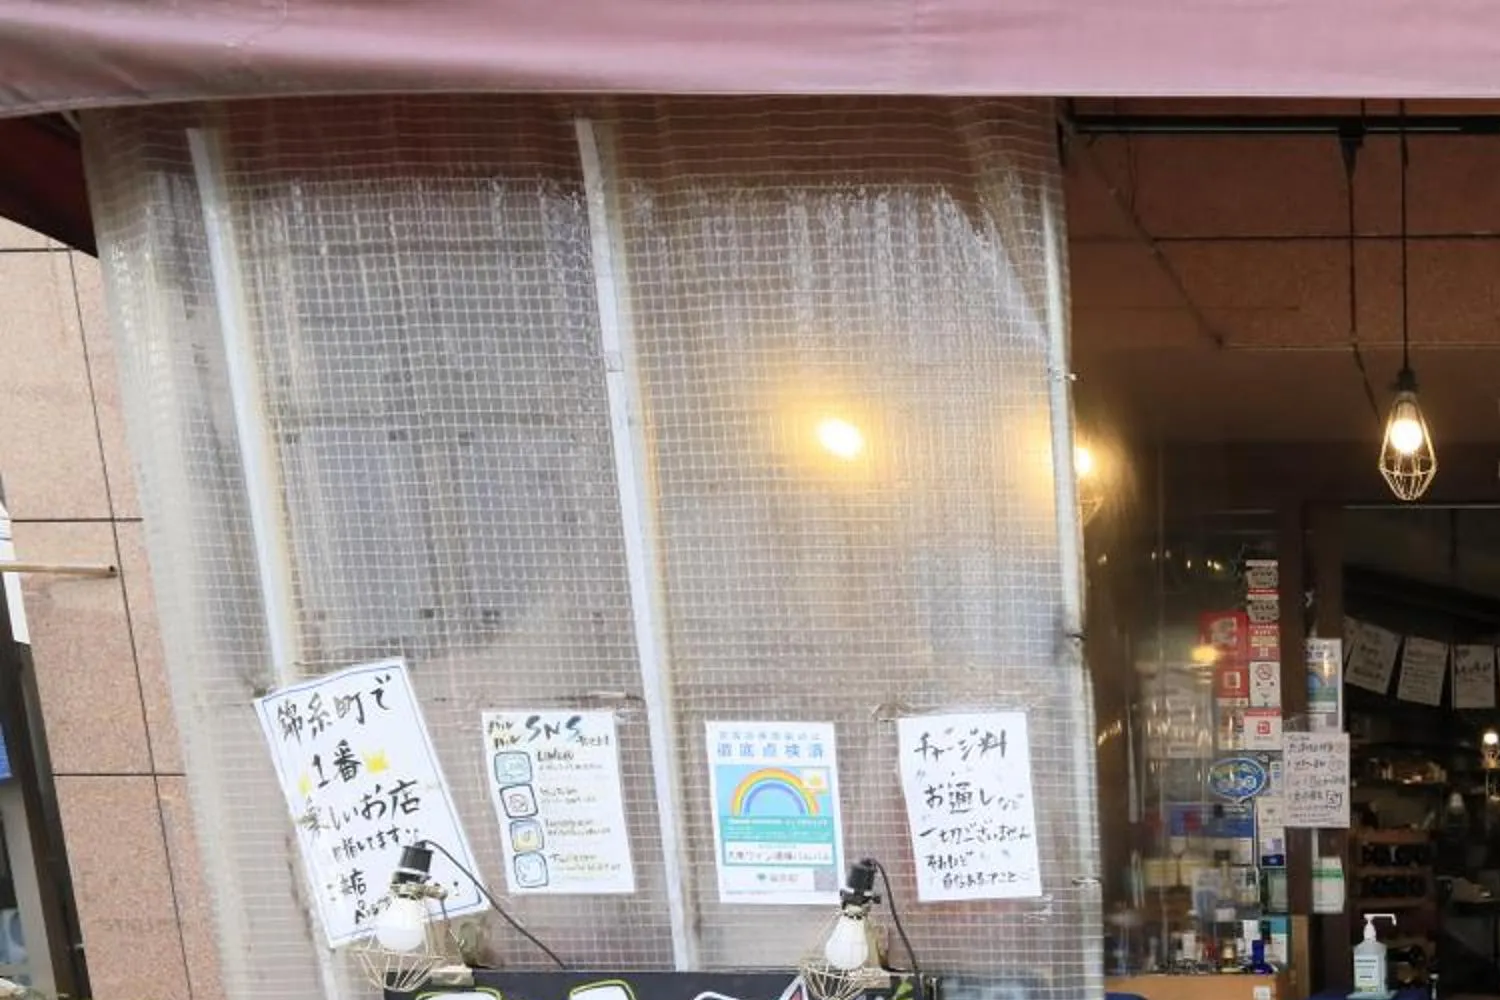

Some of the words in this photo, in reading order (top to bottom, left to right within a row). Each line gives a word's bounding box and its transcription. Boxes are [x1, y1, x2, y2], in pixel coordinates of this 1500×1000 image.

[276, 674, 392, 743] 錦糸町で
[525, 714, 582, 743] SNS
[311, 739, 362, 789] 1番
[298, 778, 421, 838] 楽しいお店
